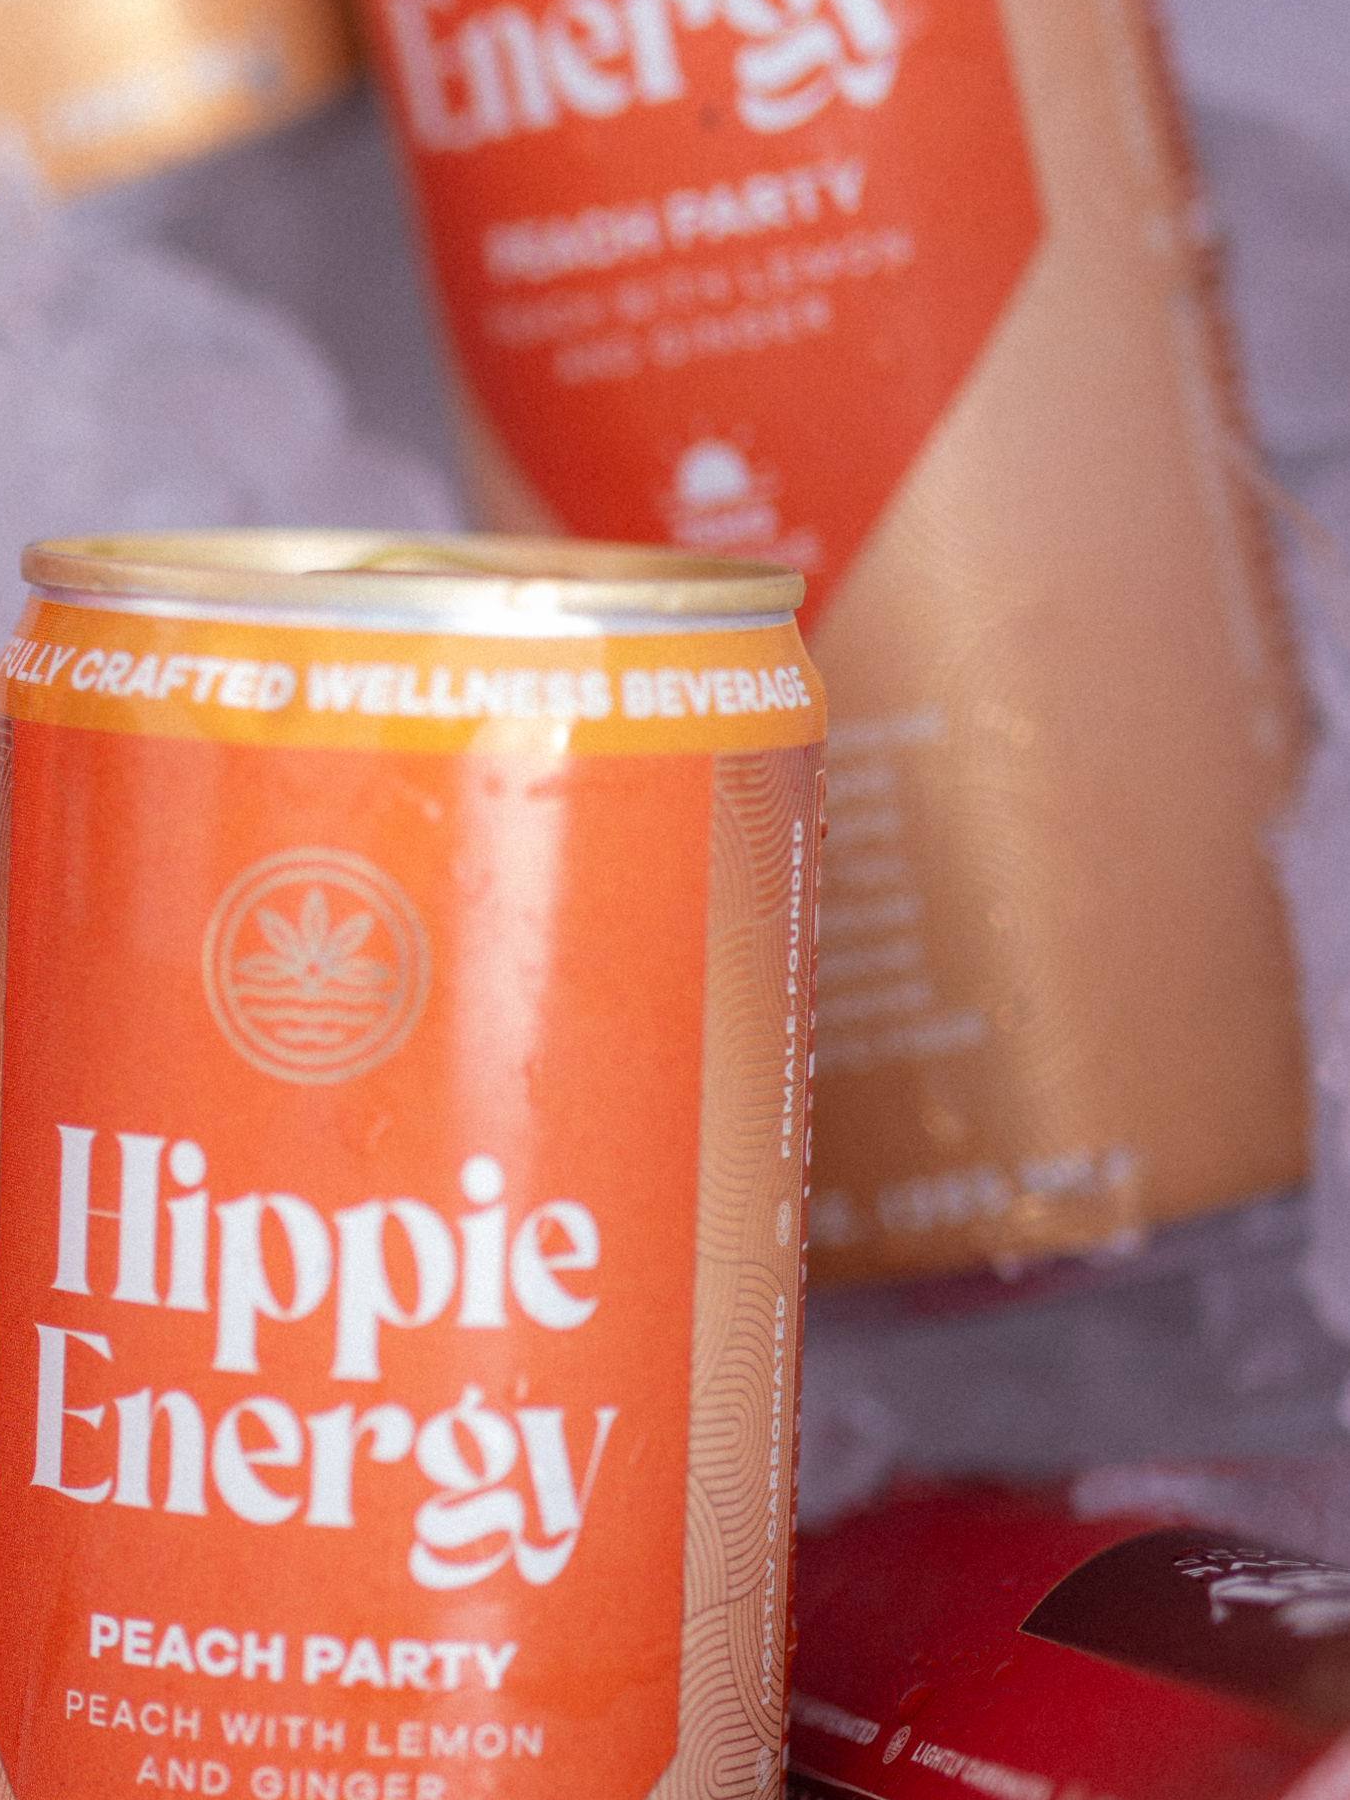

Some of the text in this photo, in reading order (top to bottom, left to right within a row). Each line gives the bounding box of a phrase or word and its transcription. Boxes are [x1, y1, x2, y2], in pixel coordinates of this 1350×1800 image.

[70, 647, 298, 714] CRAFTED
[305, 658, 613, 721] WELLNESS
[620, 664, 812, 720] BEVERAGE
[780, 819, 804, 1160] FEMALE-FOUNDED
[50, 1123, 600, 1383] Hippie
[29, 1322, 620, 1591] Energy
[760, 1294, 787, 1706] LIGHTLY CARBONATED
[88, 1612, 519, 1690] PEACH PARTY
[64, 1689, 545, 1760] PEACH WITH LEMON
[910, 1739, 968, 1780] LIGHTLY
[135, 1754, 232, 1797] AND
